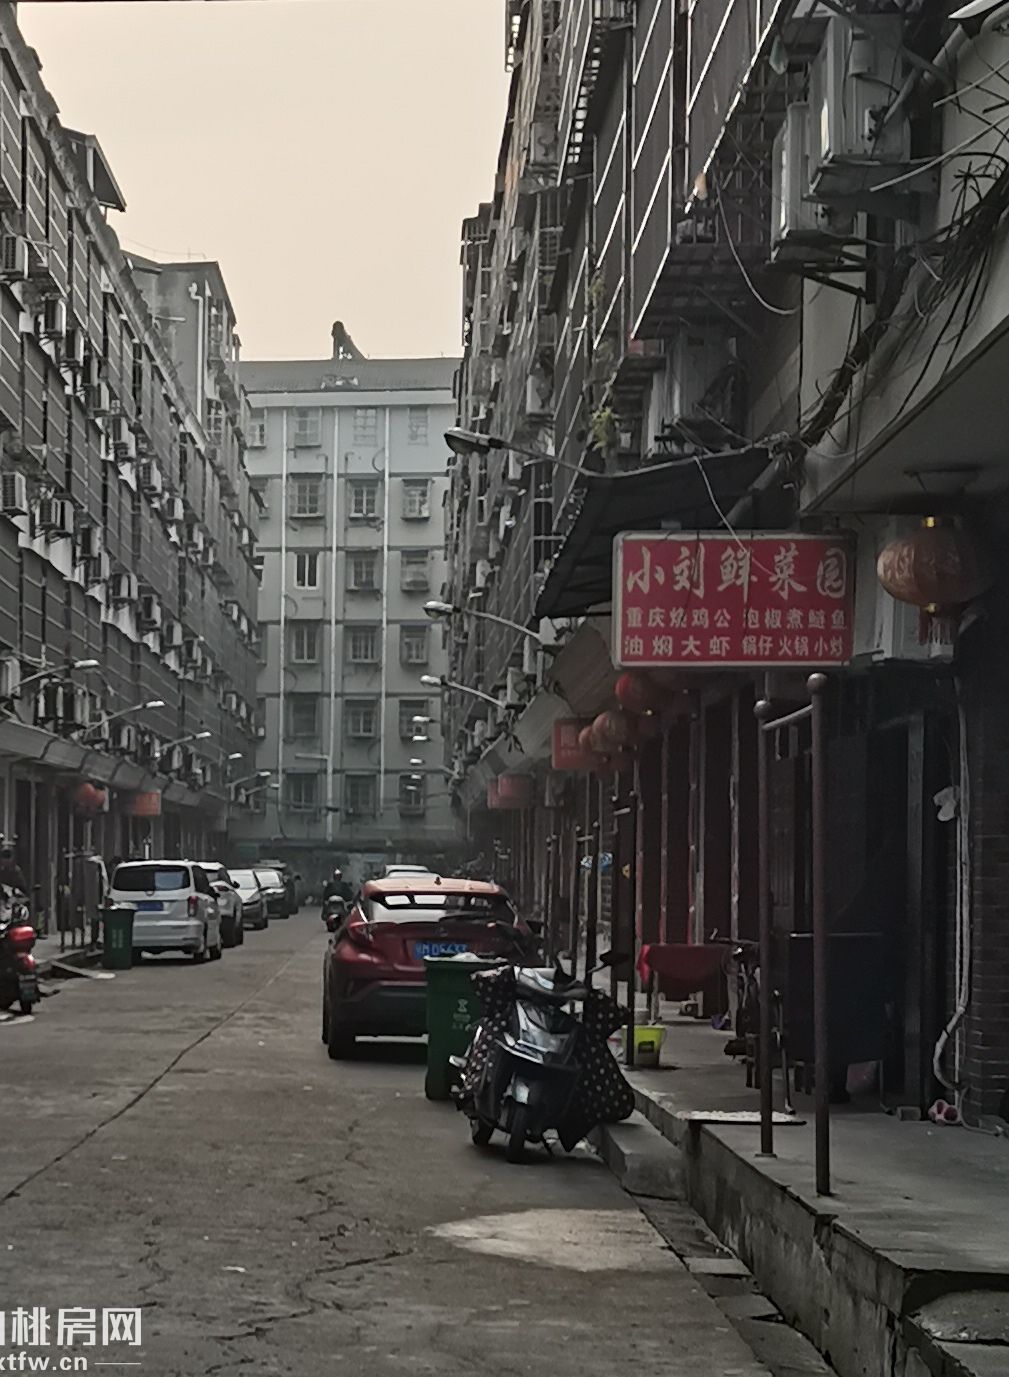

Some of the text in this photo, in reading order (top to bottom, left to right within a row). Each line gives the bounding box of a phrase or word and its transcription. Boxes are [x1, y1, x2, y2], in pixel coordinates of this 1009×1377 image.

[626, 607, 731, 628] 重庆烧鸡公
[624, 635, 731, 657] 油焖大虾
